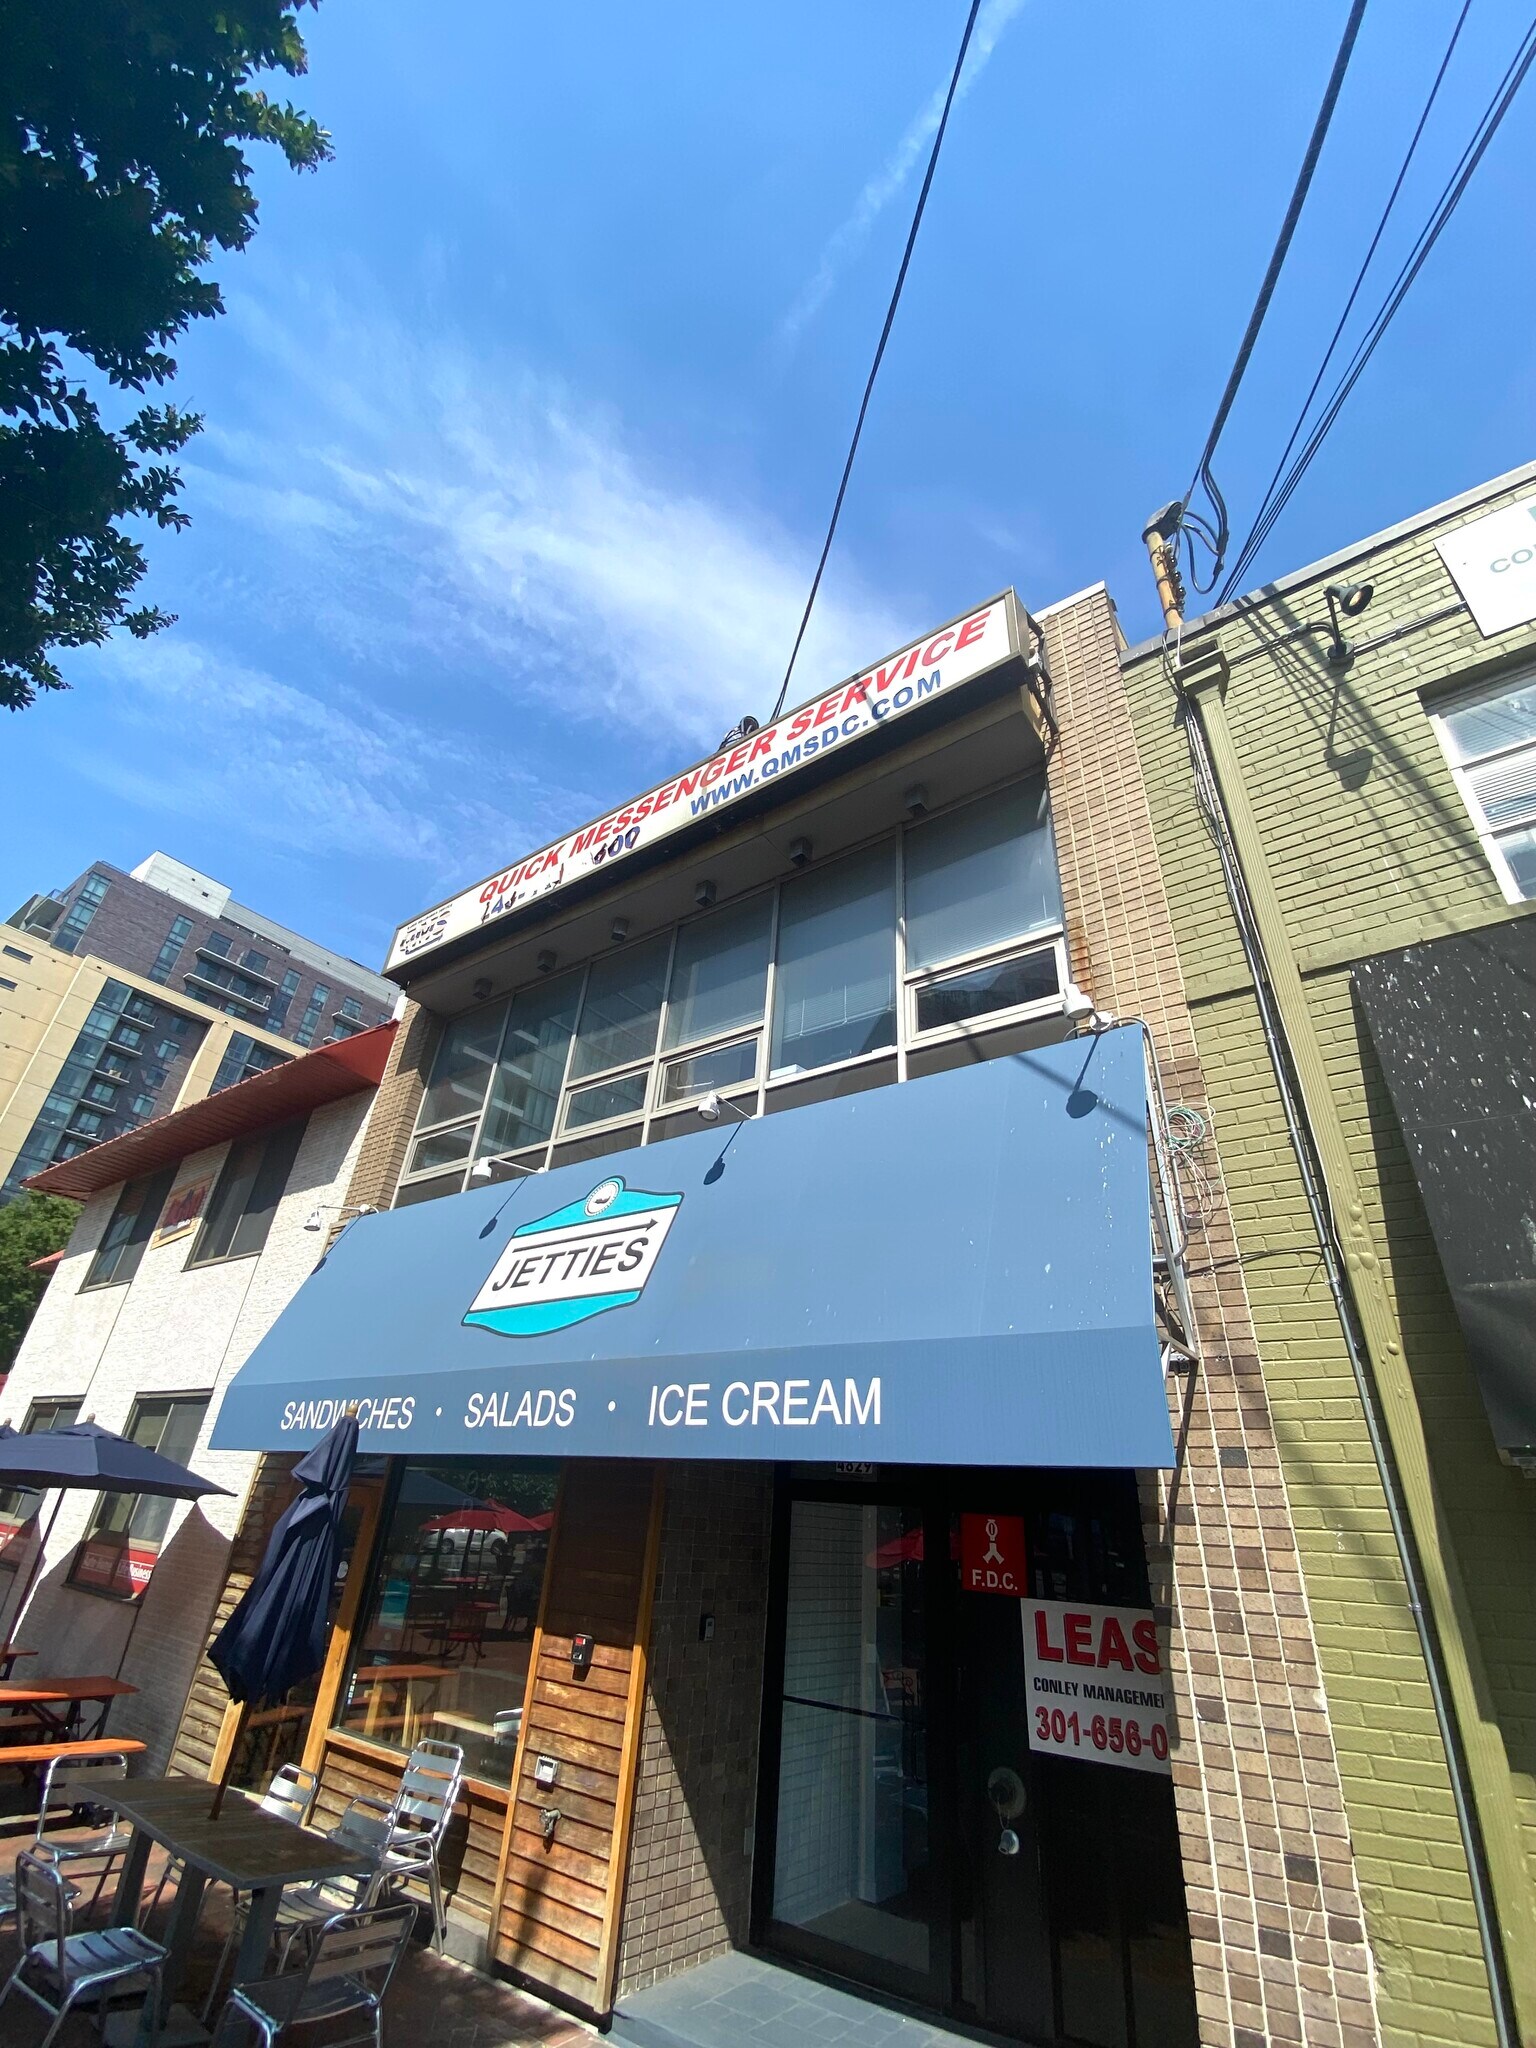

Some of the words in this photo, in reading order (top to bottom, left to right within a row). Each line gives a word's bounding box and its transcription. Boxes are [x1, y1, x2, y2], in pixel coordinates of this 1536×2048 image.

[1490, 543, 1536, 573] CO
[479, 843, 567, 904] QUICK
[569, 729, 777, 859] MESSENGER
[786, 609, 992, 741] SERVICE
[690, 669, 941, 816] WWW.QMSDC.COM
[491, 1236, 649, 1292] JETTIES
[280, 1396, 416, 1430] SANDWCHES
[464, 1388, 577, 1428] SALADS
[648, 1383, 711, 1427] ICE
[721, 1377, 881, 1427] CREAM
[972, 1568, 1018, 1590] F.D.C.
[1033, 1677, 1079, 1697] CONLEY
[1035, 1705, 1168, 1761] 301-656-0
